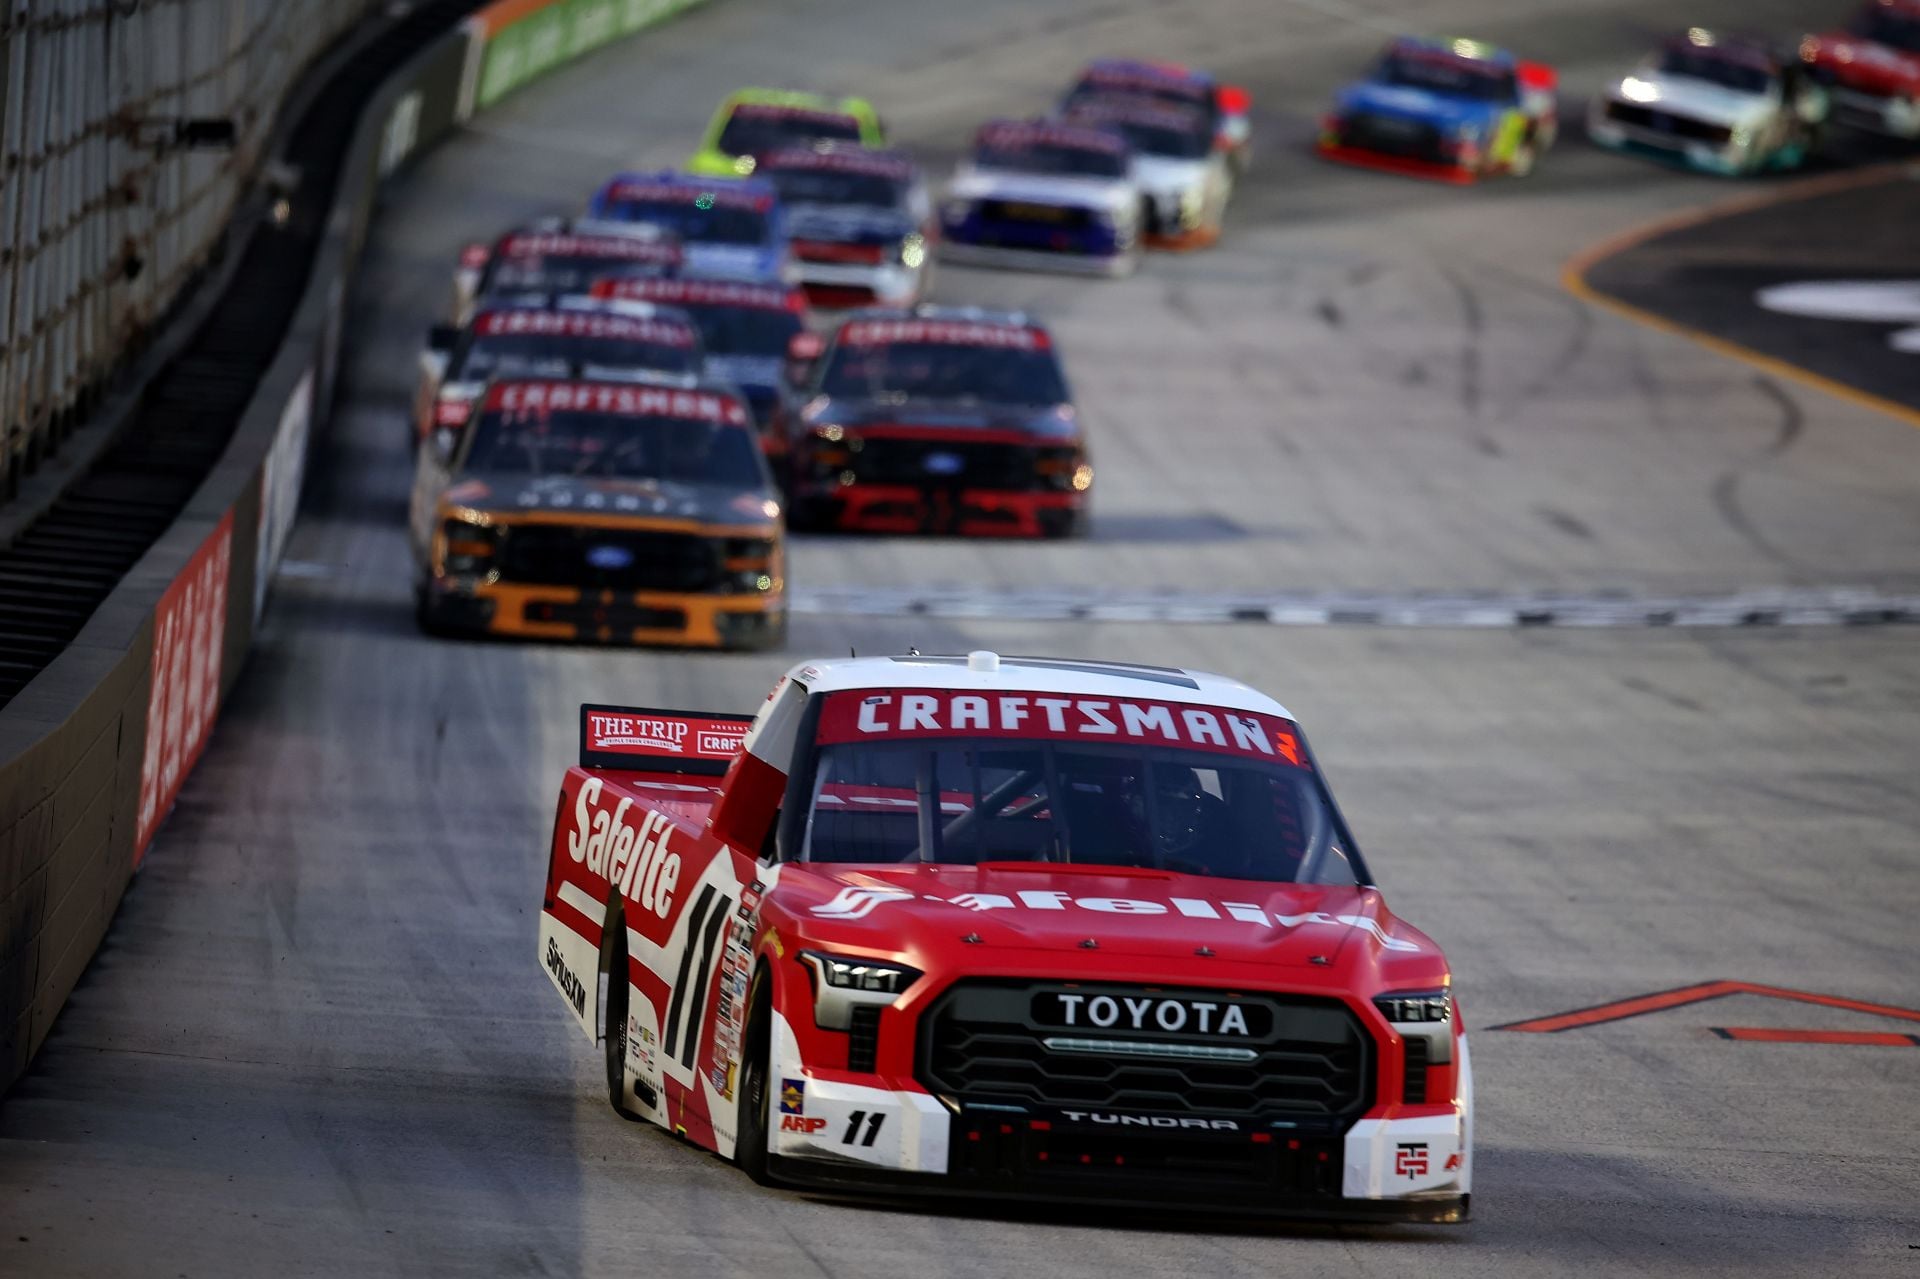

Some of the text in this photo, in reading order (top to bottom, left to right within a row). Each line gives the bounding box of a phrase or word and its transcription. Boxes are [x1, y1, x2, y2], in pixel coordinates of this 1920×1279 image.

[502, 381, 723, 419] CRAFTSMAN
[591, 716, 689, 743] THE TRIP
[857, 694, 1276, 756] CRAFTSMAN
[568, 777, 682, 920] Safelite
[547, 936, 586, 1019] SiriusXM
[664, 883, 733, 1071] 11
[1058, 994, 1249, 1036] TOYOTA
[781, 1114, 827, 1134] ARP
[842, 1110, 886, 1147] 11
[1061, 1109, 1240, 1131] TUNDRA
